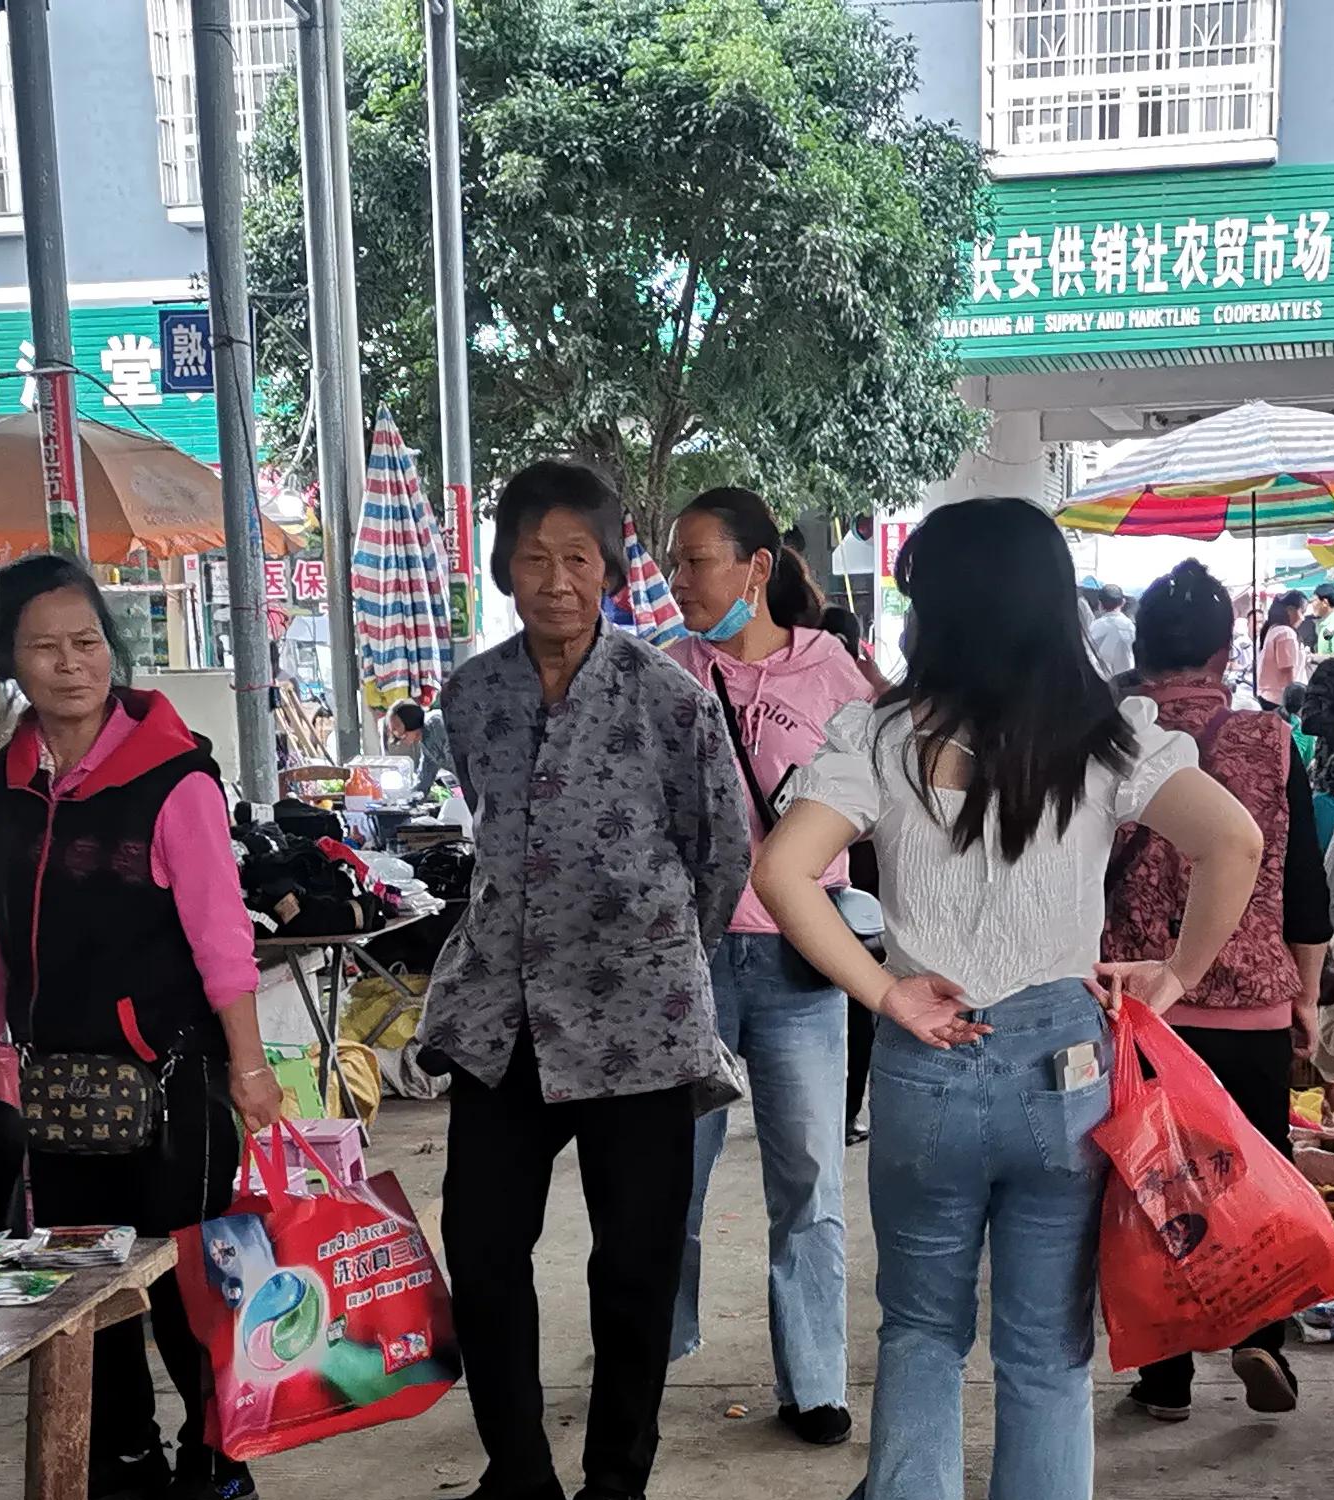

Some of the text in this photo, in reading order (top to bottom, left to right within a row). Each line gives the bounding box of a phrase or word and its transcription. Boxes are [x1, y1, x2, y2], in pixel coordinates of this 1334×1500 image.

[971, 211, 1333, 302] 长安供销社农贸市场
[1045, 311, 1095, 333] SUPPLY
[1097, 310, 1125, 330] AND
[264, 559, 326, 600] 医保
